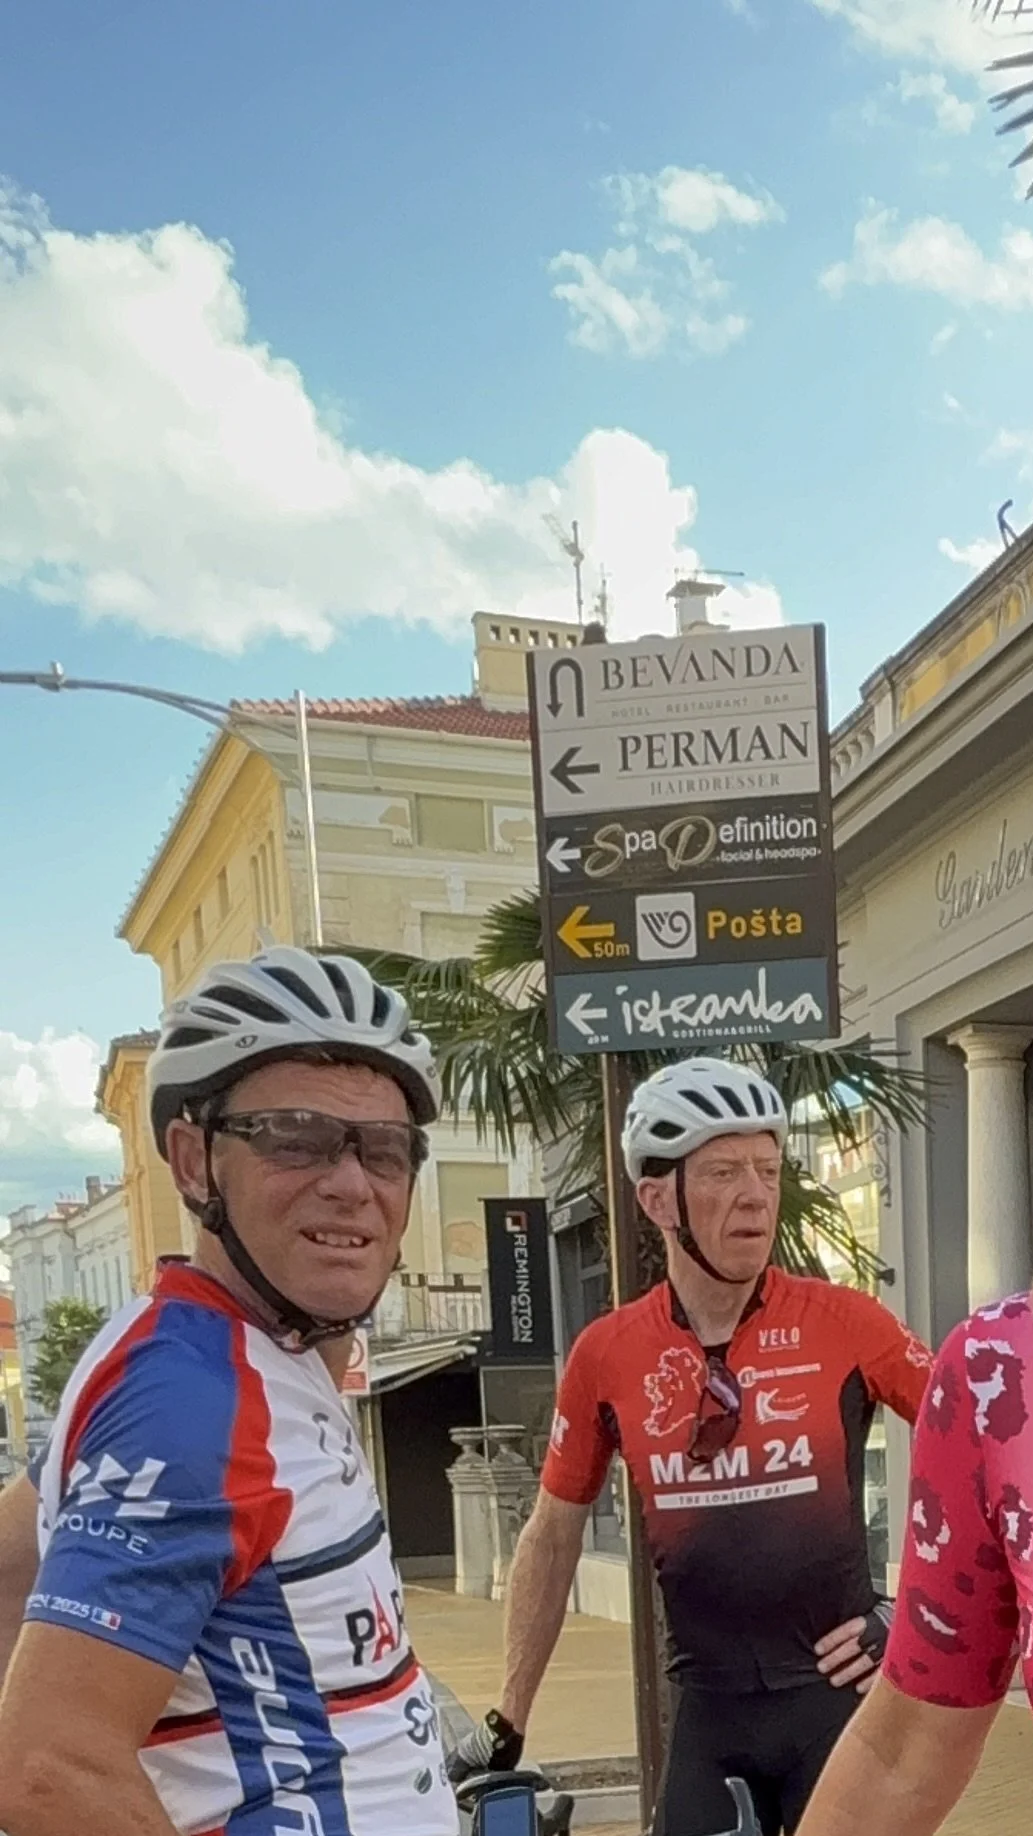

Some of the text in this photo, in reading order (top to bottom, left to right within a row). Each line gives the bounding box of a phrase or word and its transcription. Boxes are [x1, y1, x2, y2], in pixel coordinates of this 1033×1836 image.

[601, 642, 801, 691] BEVANDA
[611, 694, 789, 718] HOTEL RESTAURANT BAR
[618, 721, 811, 772] PERMAN
[650, 772, 781, 796] HAIRDRESSER
[584, 814, 817, 878] Spa Definition
[707, 907, 803, 940] Pošta
[593, 941, 631, 958] 50m
[513, 1233, 533, 1343] REMINGTON
[759, 1326, 800, 1347] VELO
[763, 1435, 813, 1473] 24
